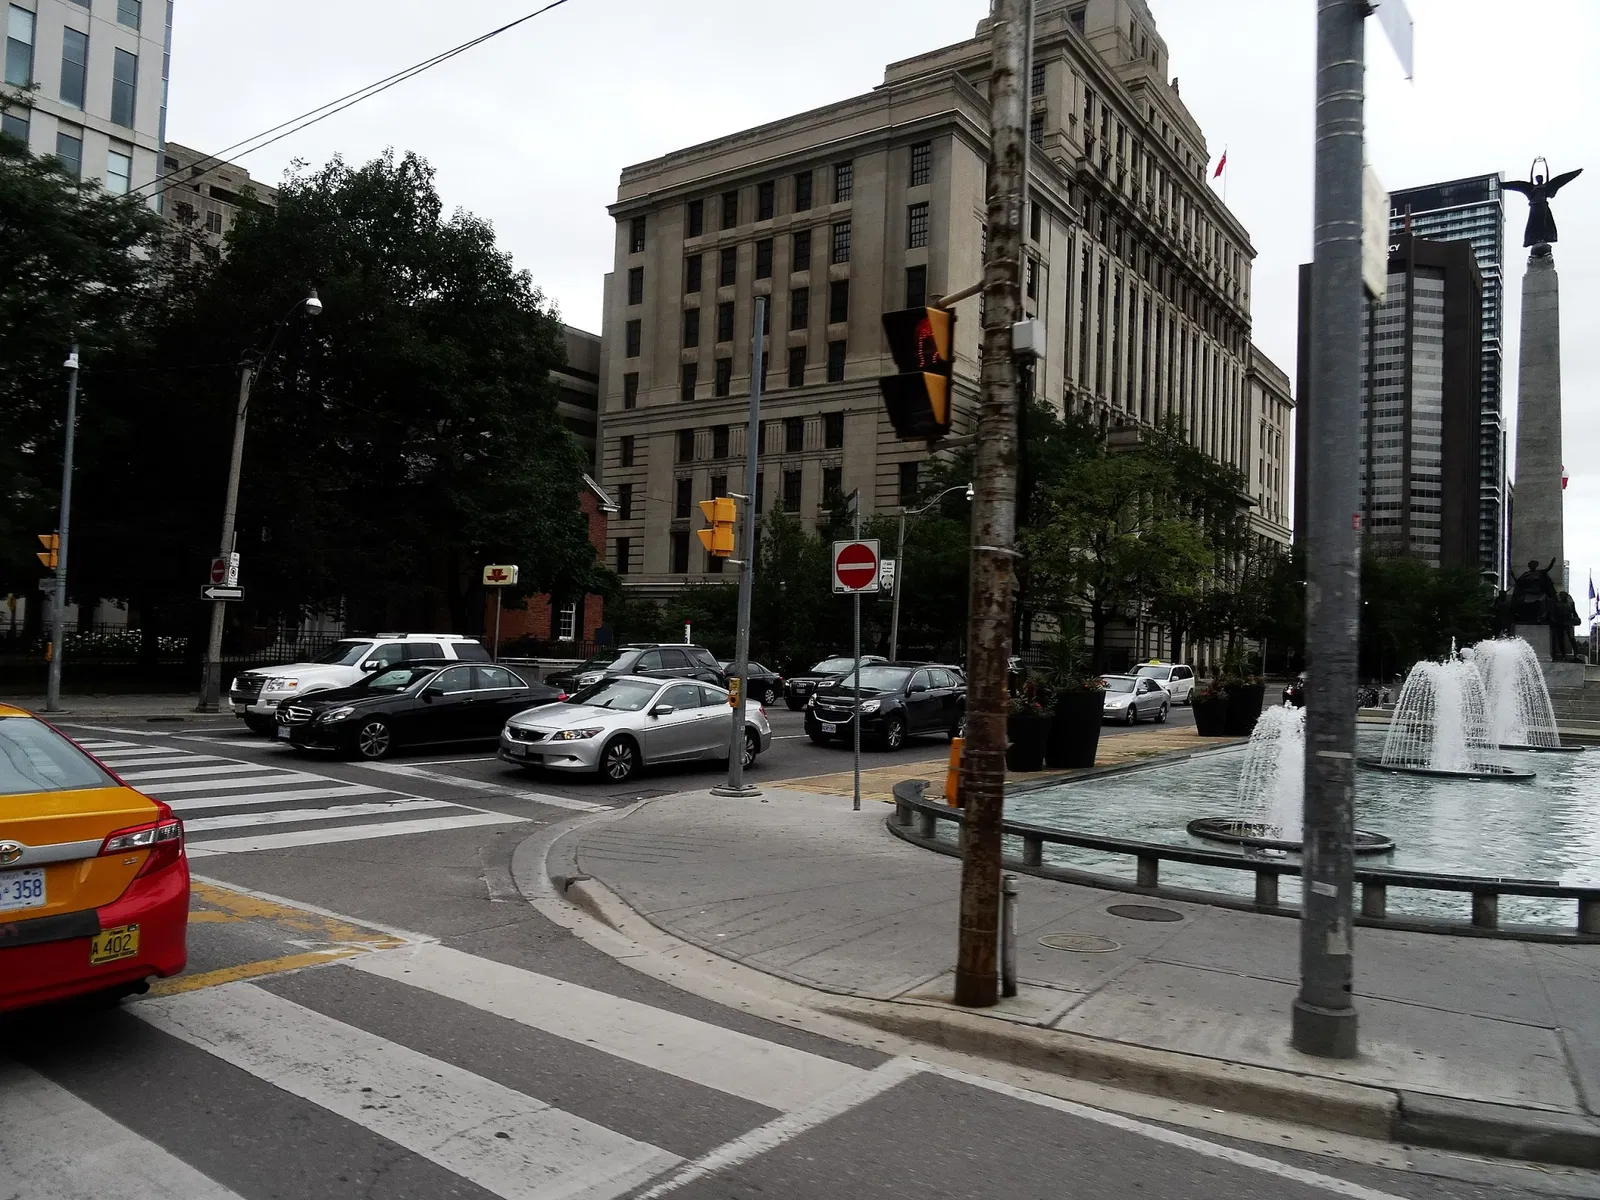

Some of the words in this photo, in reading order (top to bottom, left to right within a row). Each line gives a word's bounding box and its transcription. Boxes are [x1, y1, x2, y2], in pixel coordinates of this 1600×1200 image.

[12, 878, 42, 900] 358
[92, 942, 99, 955] A
[103, 933, 132, 954] 402
